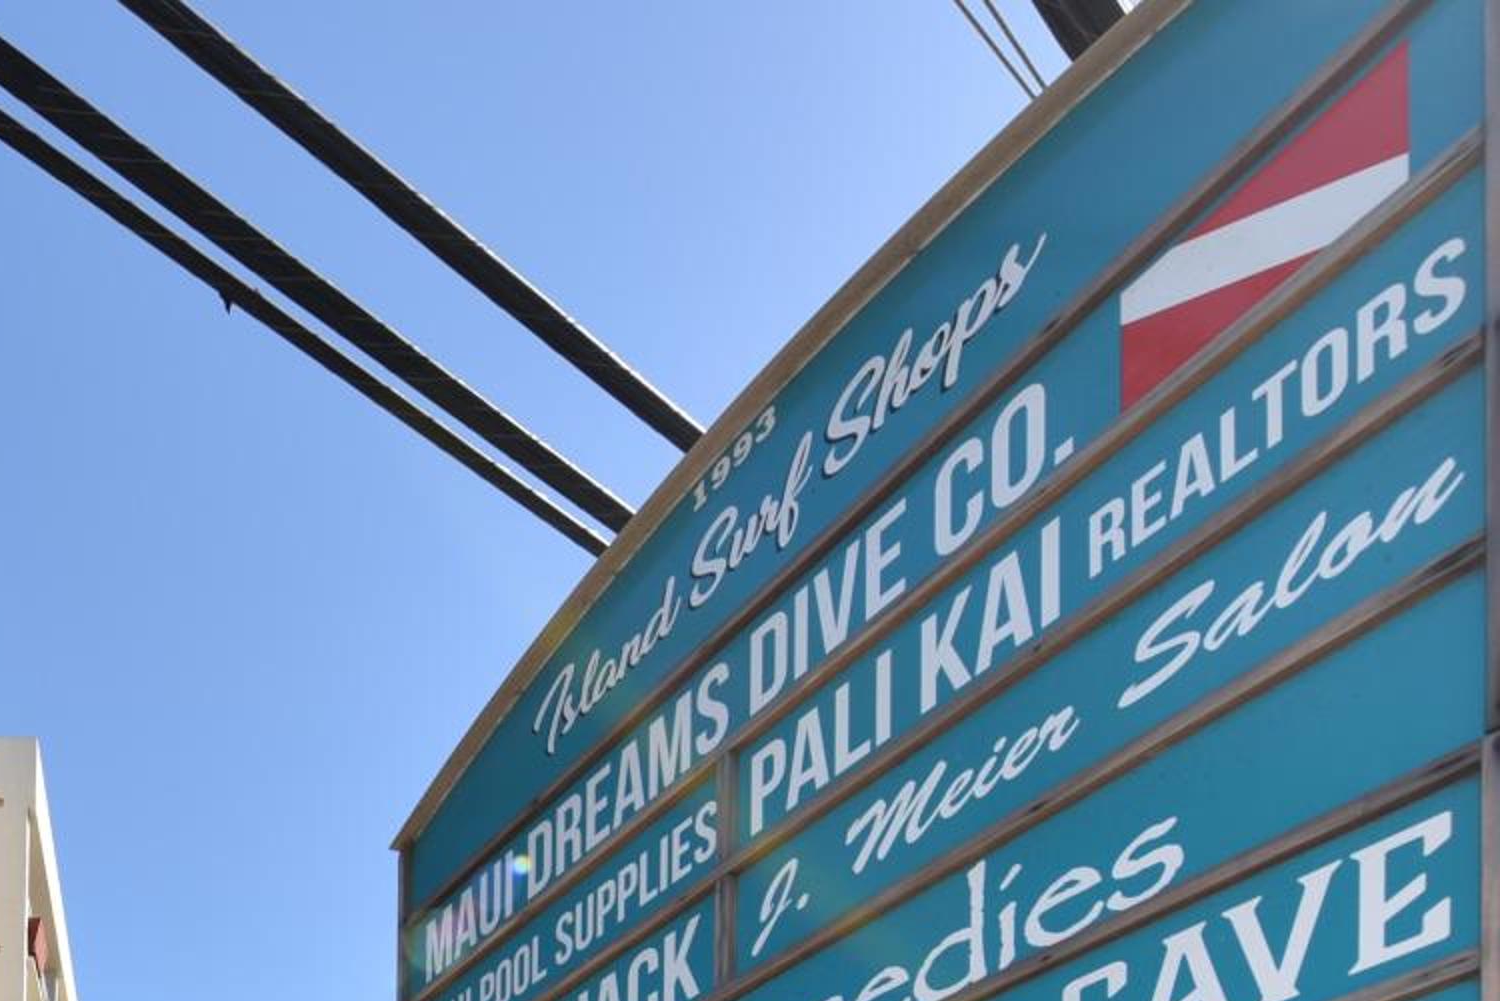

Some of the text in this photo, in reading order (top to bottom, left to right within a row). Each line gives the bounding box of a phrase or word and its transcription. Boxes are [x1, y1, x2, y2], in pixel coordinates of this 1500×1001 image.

[424, 383, 1074, 985] MAUI DREAMS DIVE CO.
[532, 233, 1048, 753] Island Surf Shops
[693, 405, 777, 512] 1993
[750, 237, 1466, 836] PALI KAI REALTORS
[752, 457, 1464, 957] J. Meier Salon
[554, 801, 718, 966] SUPPLIES
